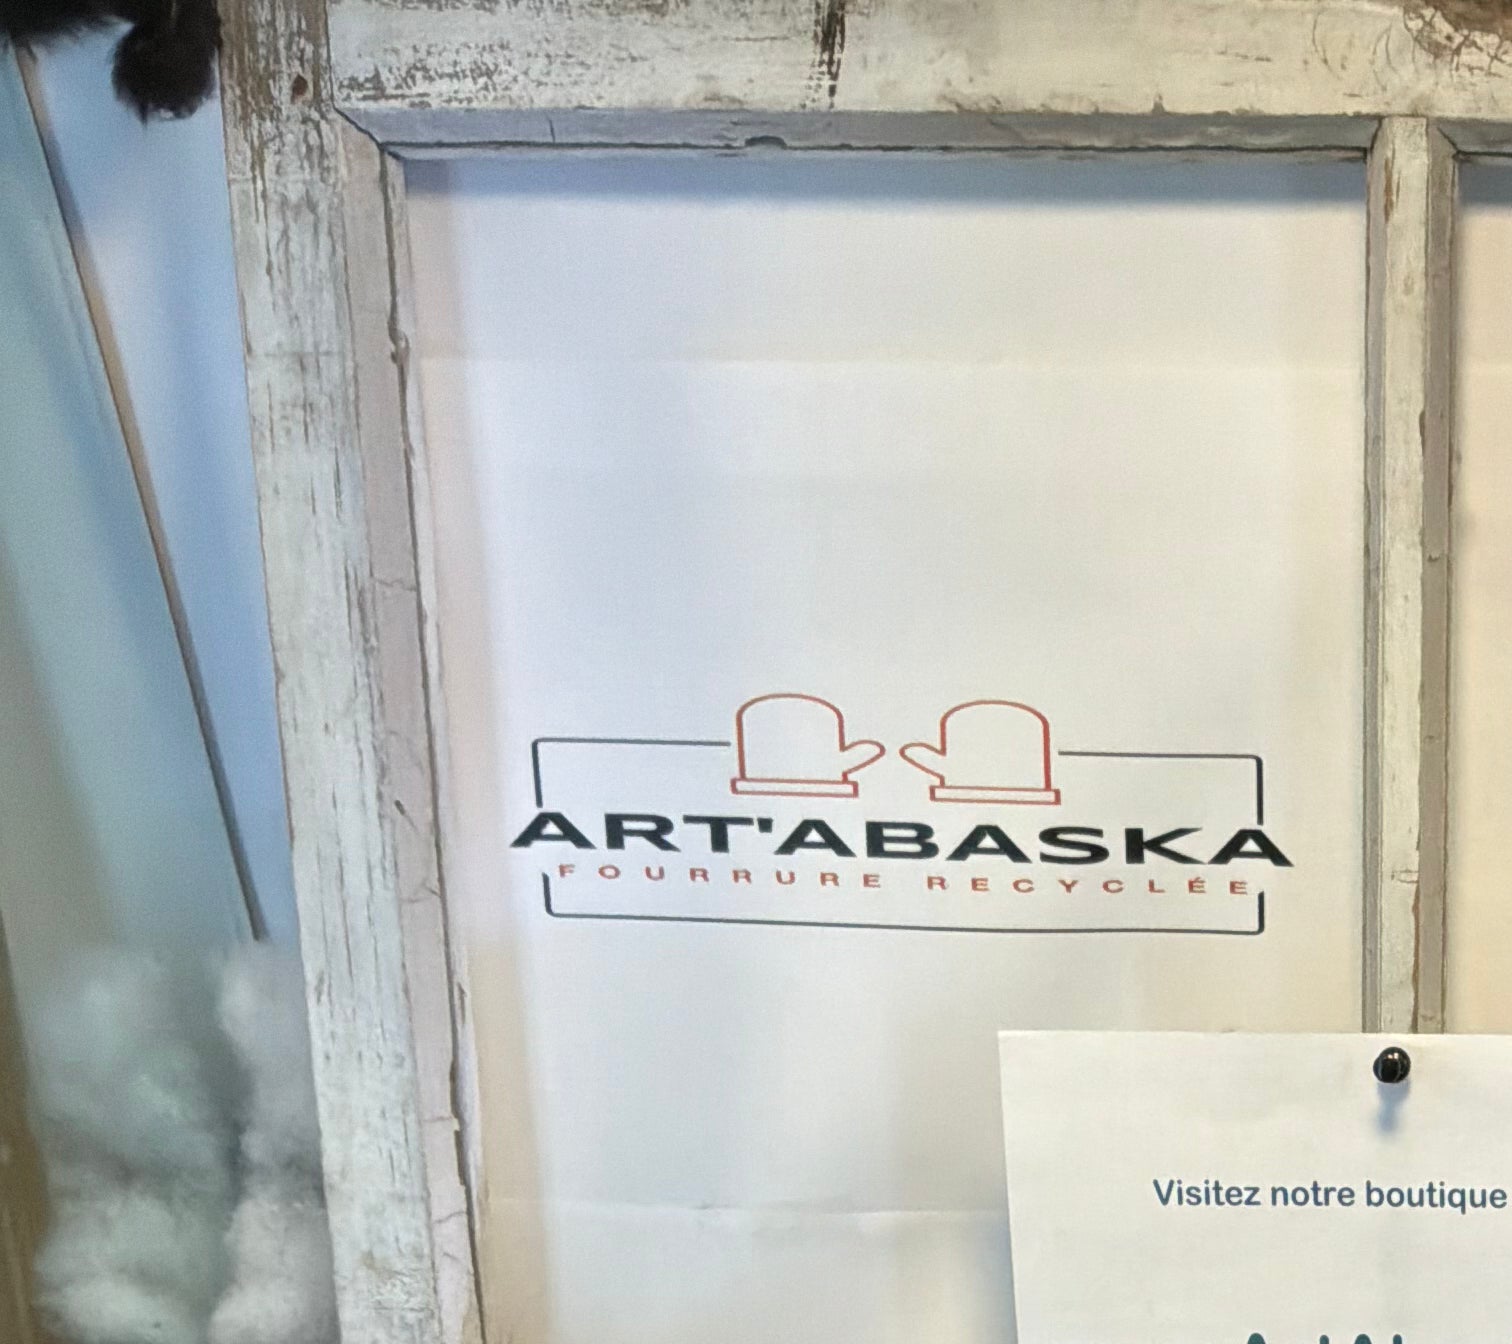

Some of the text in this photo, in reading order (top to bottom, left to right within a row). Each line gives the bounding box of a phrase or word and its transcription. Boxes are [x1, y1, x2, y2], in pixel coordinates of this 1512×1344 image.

[510, 810, 1295, 868] ART'ABASKA
[558, 862, 1253, 897] FOURRURE RECYCLÉE
[1152, 1178, 1261, 1207] Visitez
[1271, 1181, 1356, 1208] notre
[1366, 1180, 1508, 1216] boutique
